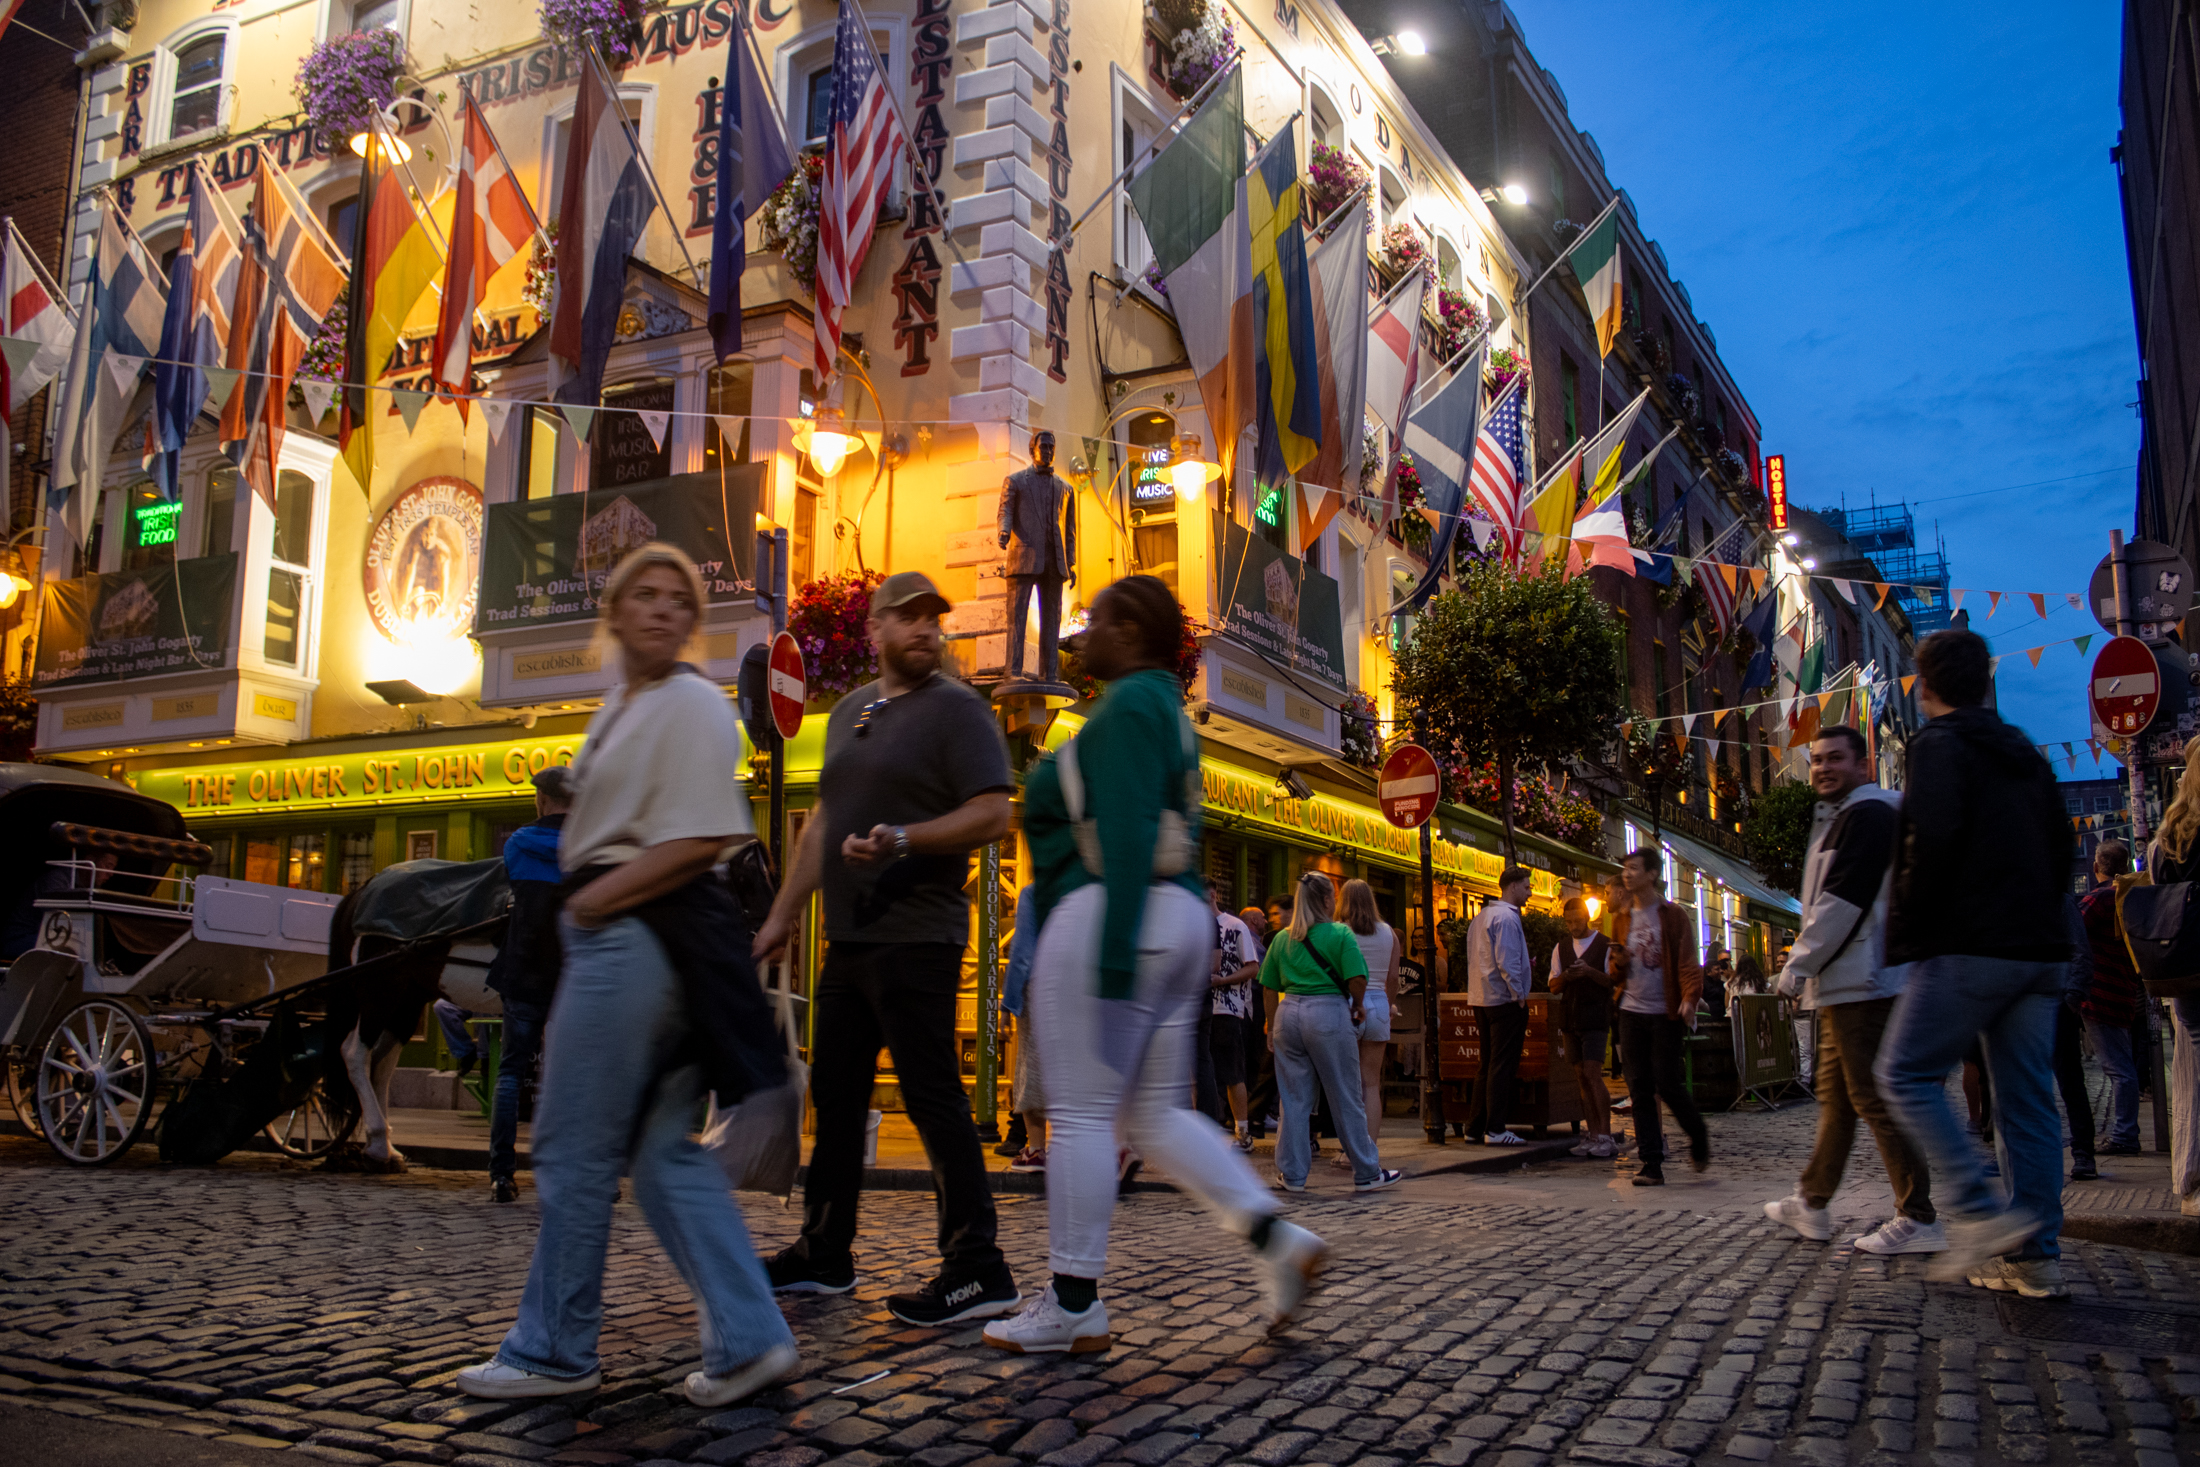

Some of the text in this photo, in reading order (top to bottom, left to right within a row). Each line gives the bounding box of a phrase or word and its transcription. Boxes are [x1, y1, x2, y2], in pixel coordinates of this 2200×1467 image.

[125, 62, 152, 160] BAR
[617, 416, 645, 435] IRIS
[608, 437, 656, 460] MUSIC
[1142, 448, 1168, 463] LIVE
[615, 460, 650, 482] BAR
[419, 484, 457, 507] JOHN
[1136, 483, 1173, 499] MUSIC
[1770, 457, 1786, 528] HOSTEL
[139, 527, 176, 547] FOOD
[398, 507, 425, 532] 1835
[426, 503, 467, 529] TEMPLE
[465, 527, 479, 557] BAR
[486, 608, 518, 623] Trad
[519, 602, 580, 619] Sessions
[582, 598, 593, 611] &
[714, 578, 752, 596] Days
[515, 583, 544, 600] The
[1234, 602, 1253, 621] The
[1253, 611, 1277, 634] Oliver
[1286, 628, 1302, 648] John
[1301, 636, 1329, 663] Gogarty
[59, 649, 77, 664] The
[77, 646, 110, 661] Oliver
[128, 640, 157, 657] John
[157, 634, 204, 652] Gogarty
[1241, 625, 1273, 650] Sessions
[1273, 639, 1279, 652] &
[1279, 642, 1294, 660] Late
[1310, 658, 1322, 674] Bar
[1322, 663, 1327, 675] 7
[1326, 665, 1343, 684] Days
[37, 669, 59, 683] Trad
[59, 664, 101, 680] Sessions
[101, 663, 111, 675] &
[112, 660, 135, 674] Late
[136, 656, 165, 672] Night
[166, 653, 186, 667] Bar
[262, 696, 287, 716] bar
[183, 774, 237, 807] THE
[248, 765, 348, 803] OLIVER
[362, 758, 405, 795] ST.
[410, 752, 486, 791] JOHN
[1271, 786, 1303, 828] THE
[1309, 800, 1359, 843] OLIVER
[1364, 815, 1382, 848] ST.
[1383, 824, 1411, 856] JOHN
[1471, 850, 1499, 878] TEMPLE
[986, 843, 999, 1057] ENTHOUSE APARTMENTS
[1454, 1026, 1465, 1036] &
[945, 1280, 984, 1307] HOKA
